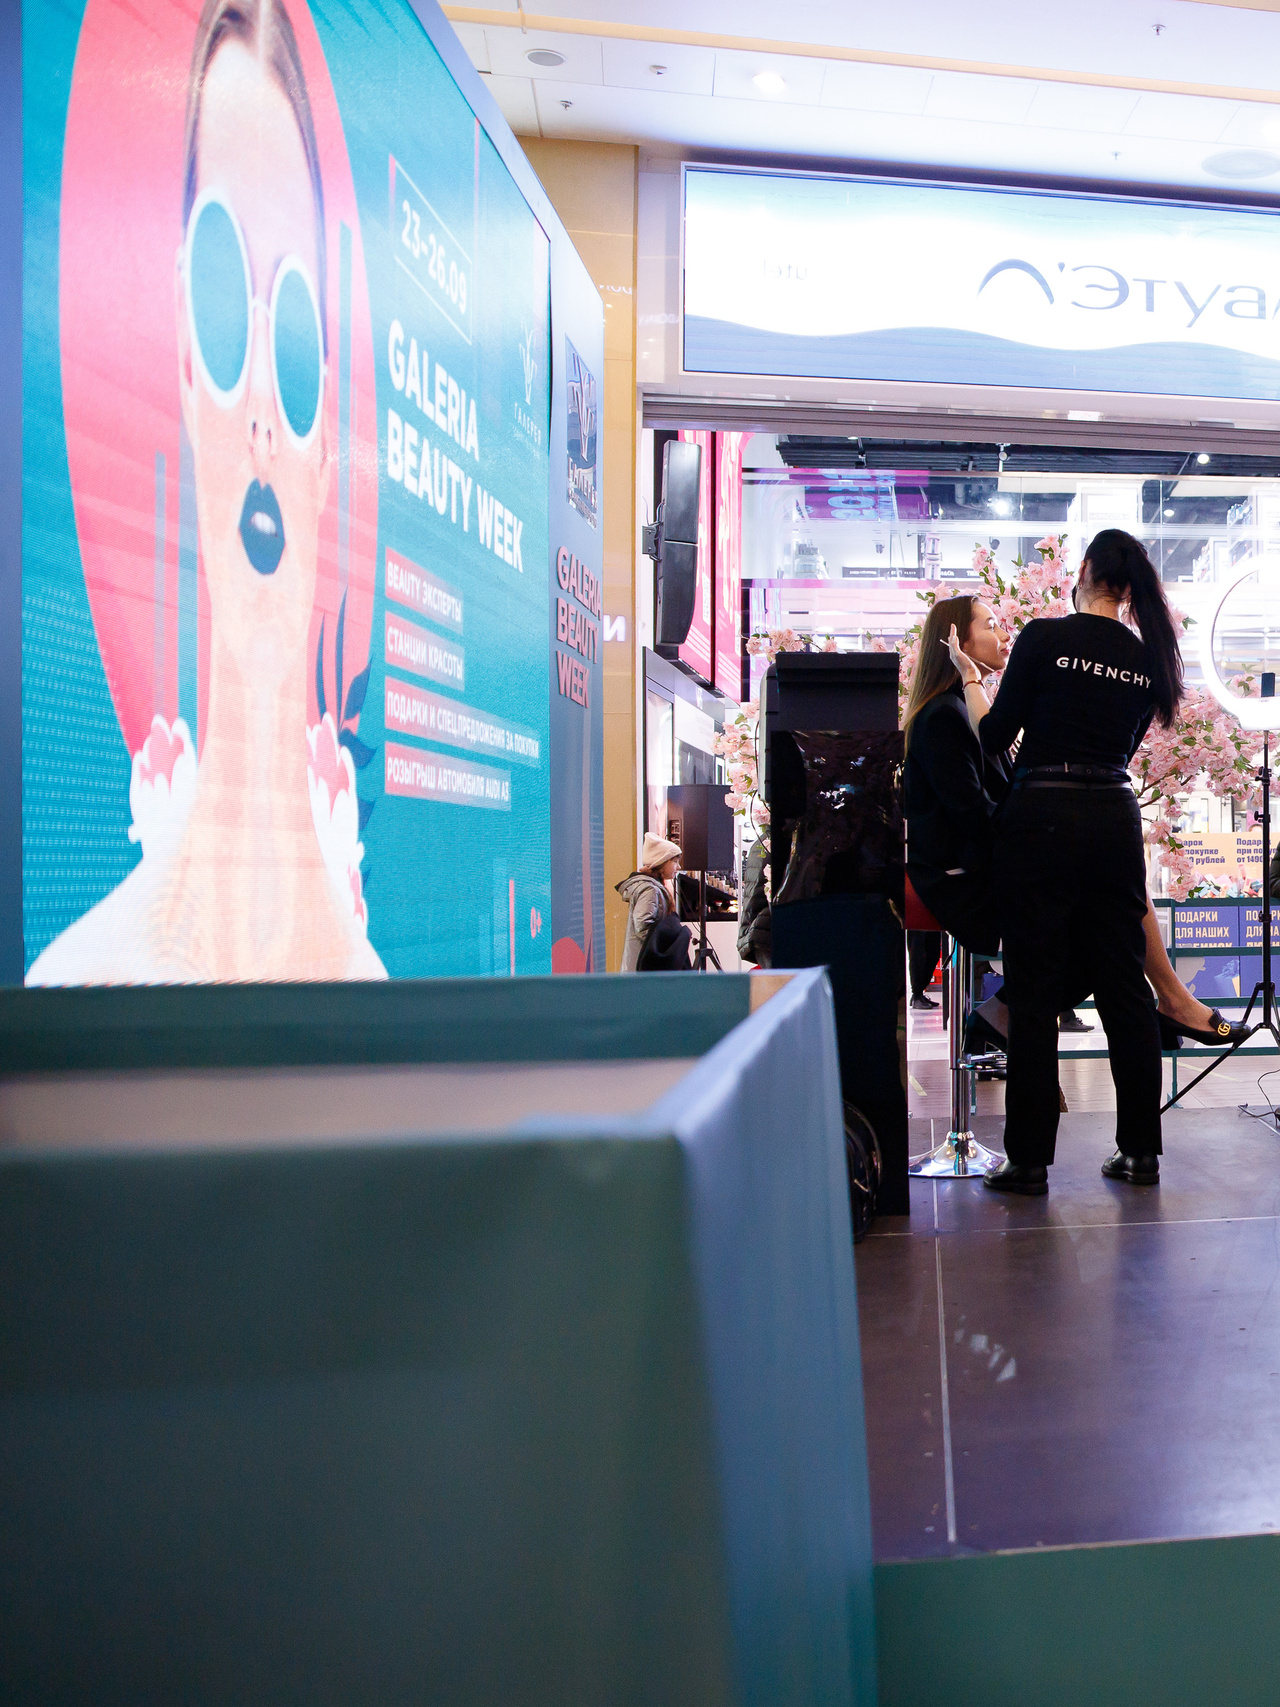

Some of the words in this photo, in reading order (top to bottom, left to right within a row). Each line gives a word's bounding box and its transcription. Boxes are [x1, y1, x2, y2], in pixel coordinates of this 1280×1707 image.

[402, 199, 466, 315] 23-26.09
[388, 318, 479, 462] GALERIA
[387, 407, 472, 533] BEAUTY
[477, 484, 523, 573] WEEK
[387, 561, 421, 600] BEAUTY
[422, 580, 461, 622] ЭКСПЕРТЫ
[557, 546, 601, 621] GALERIA
[387, 626, 427, 665] СТАНЦИИ
[428, 645, 463, 680] КРАСОТЫ
[557, 597, 599, 664] BEAUTY
[556, 650, 589, 709] WEEK
[1056, 656, 1151, 689] GIVENCHY
[387, 691, 428, 727] ПОДАРКИ
[429, 704, 436, 729] И
[387, 757, 436, 789] РОЗЫГРЫШ
[1196, 856, 1225, 865] рублей
[1174, 911, 1218, 923] ПОДАРКИ
[1175, 927, 1193, 939] ДЛЯ
[1195, 927, 1229, 938] НАШИХ
[1246, 926, 1263, 937] ДЛЯ
